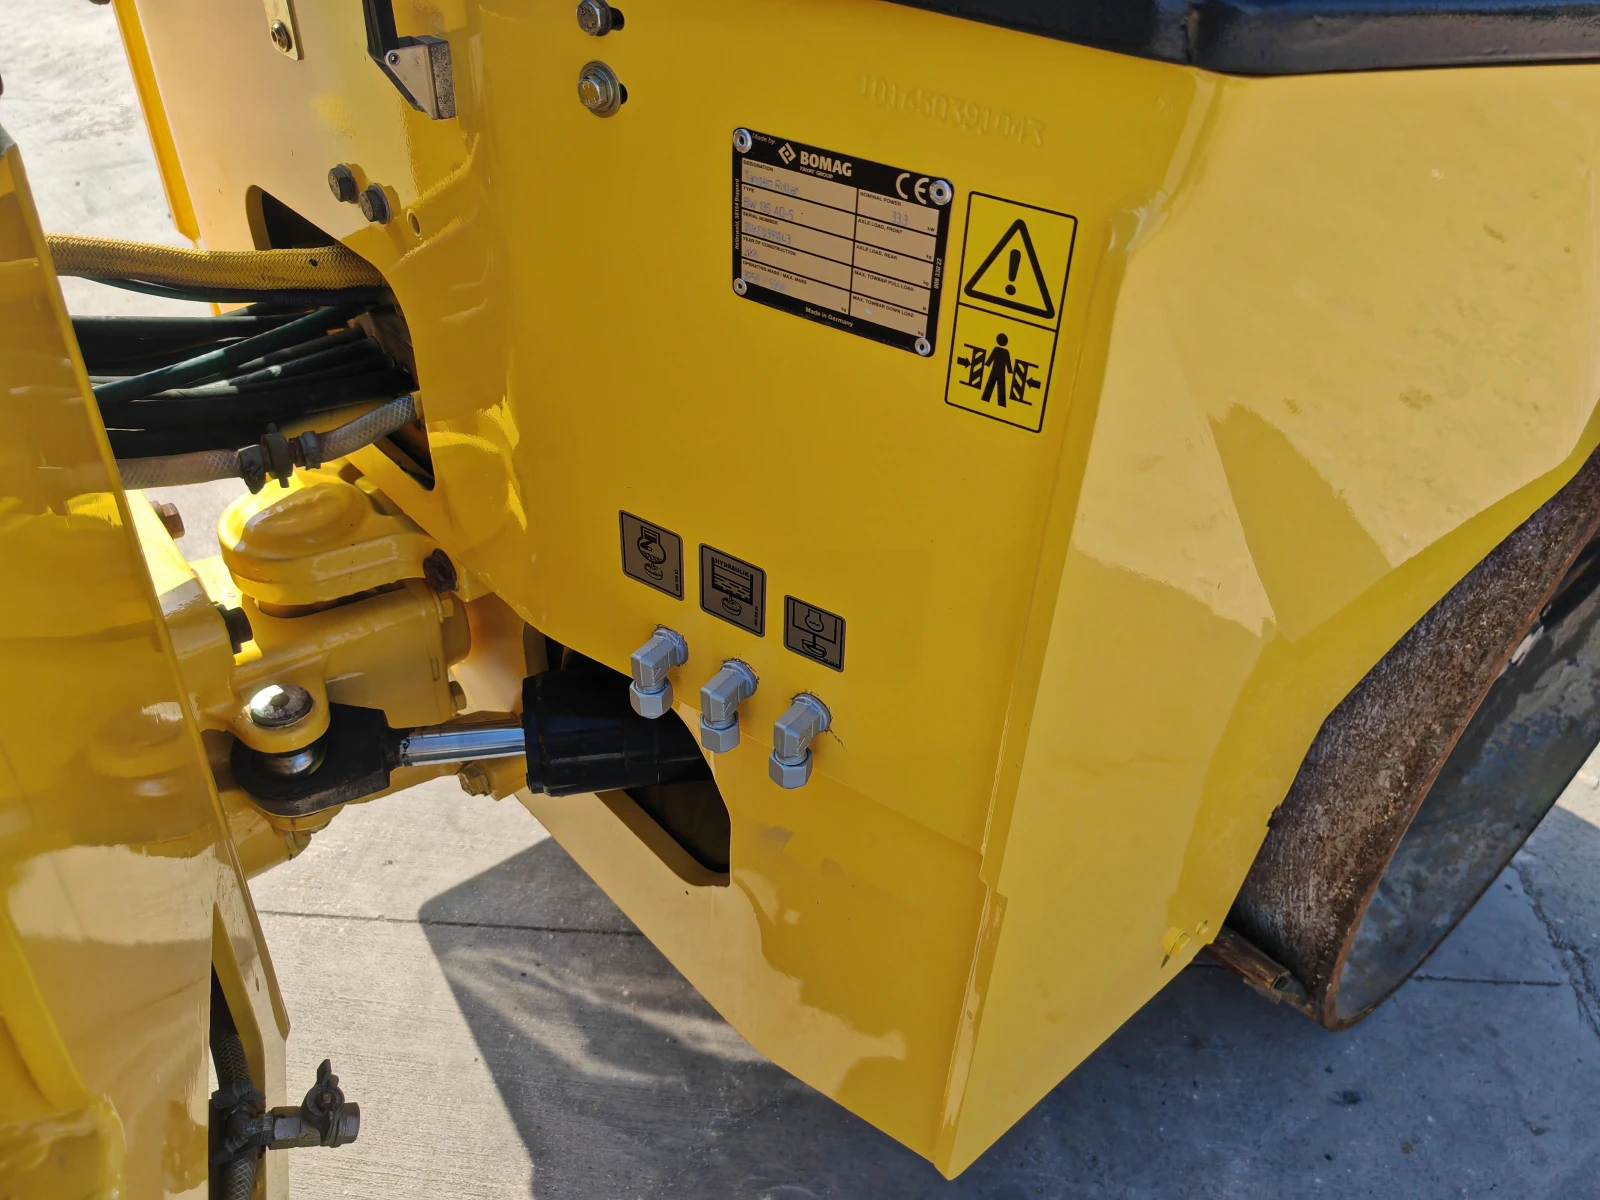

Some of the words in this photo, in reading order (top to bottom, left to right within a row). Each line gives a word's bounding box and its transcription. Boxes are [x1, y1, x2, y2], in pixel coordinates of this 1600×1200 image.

[752, 133, 768, 142] Made
[743, 160, 774, 172] DESIGNATION
[800, 150, 852, 177] BOMAG
[815, 170, 834, 179] GROUP
[896, 172, 930, 205] CE
[860, 192, 882, 201] NOMINAL
[883, 197, 902, 206] POWER
[743, 211, 758, 220] SERIAL
[759, 216, 778, 225] NUMBER
[871, 222, 886, 230] LOAD,
[886, 226, 902, 235] FRONT
[762, 241, 796, 256] CONSTRUCTION
[856, 244, 869, 252] AXLE
[869, 248, 883, 257] LOAD,
[884, 252, 898, 260] REAR
[743, 261, 767, 272] OPERATING
[767, 268, 780, 276] MASS
[795, 277, 807, 285] MASS
[854, 270, 866, 278] MAX.
[867, 274, 888, 284] TOWBAR
[888, 280, 900, 288] PULL
[901, 284, 914, 292] LOAD
[853, 295, 865, 303] MAX.
[865, 298, 885, 309] TOWBAR
[886, 305, 900, 314] DOWN
[901, 310, 914, 318] LOAD
[806, 306, 821, 317] Made
[828, 314, 854, 328] Germany
[715, 558, 749, 578] HYDRAULIK
